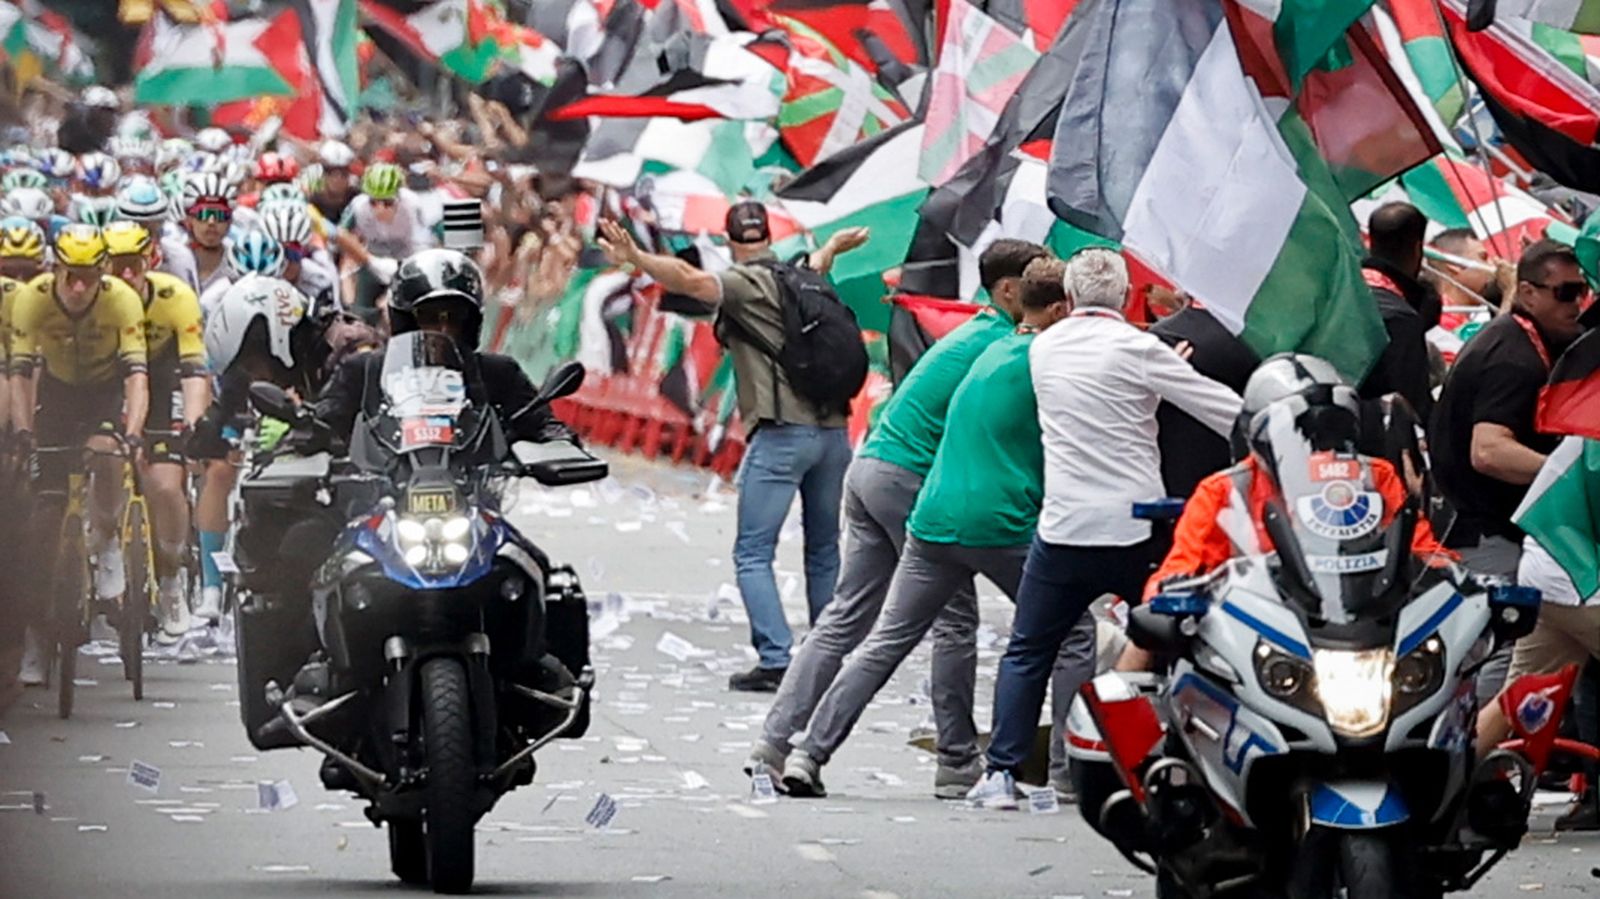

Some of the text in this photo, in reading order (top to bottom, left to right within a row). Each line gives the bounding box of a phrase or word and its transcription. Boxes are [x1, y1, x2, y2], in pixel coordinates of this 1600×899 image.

[275, 287, 294, 327] rtve
[386, 366, 464, 401] rtve
[413, 494, 448, 513] META
[1314, 556, 1379, 570] POLIZIA
